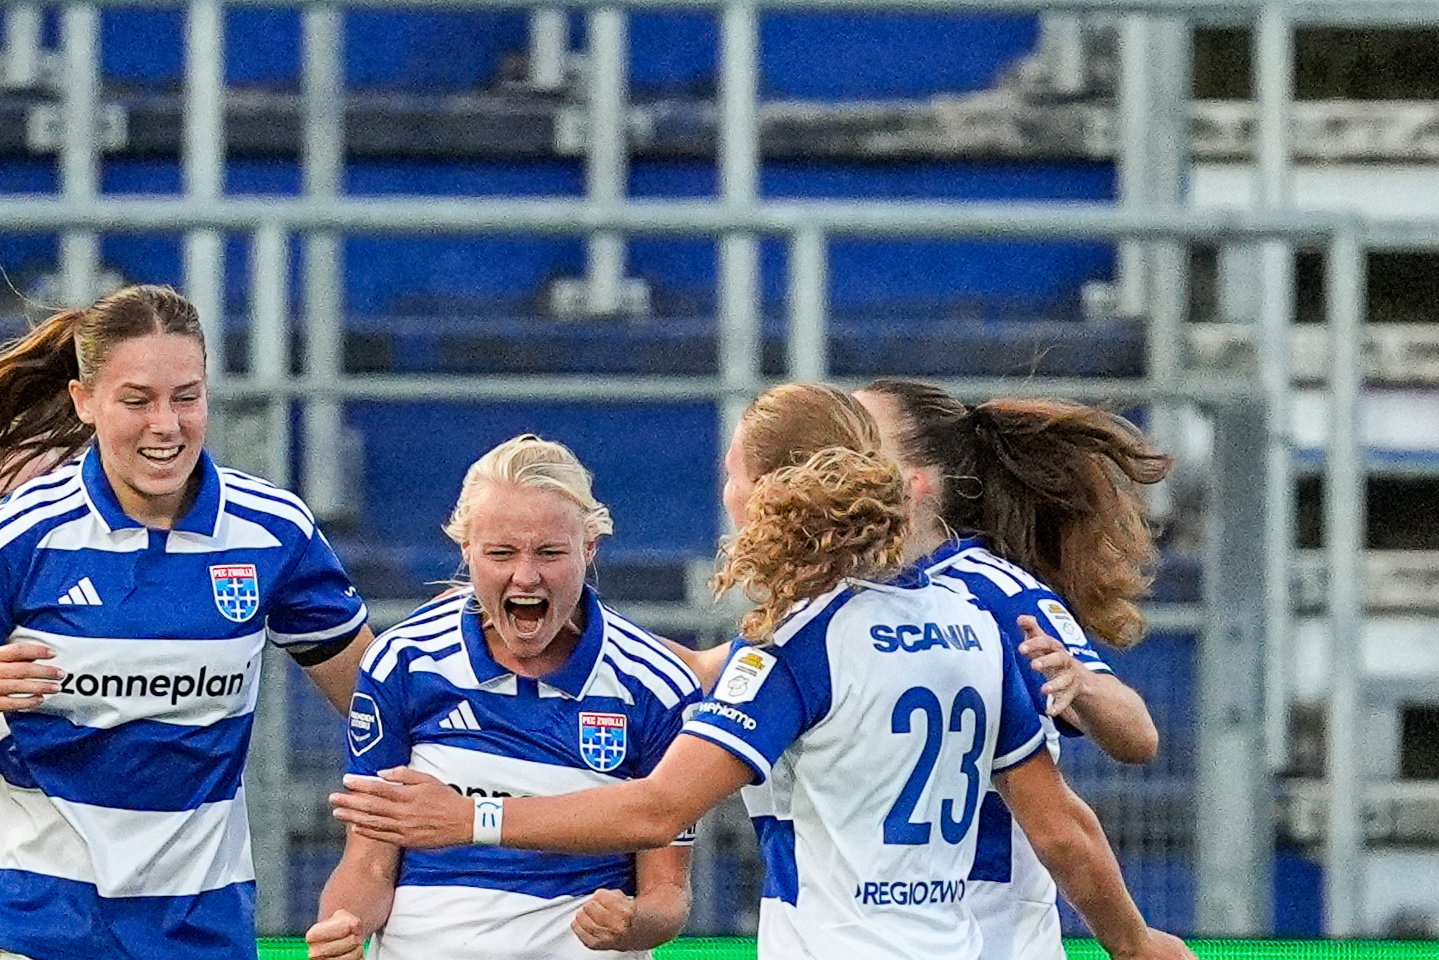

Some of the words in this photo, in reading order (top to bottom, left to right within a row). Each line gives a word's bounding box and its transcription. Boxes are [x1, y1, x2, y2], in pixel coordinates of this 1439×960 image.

[870, 623, 982, 652] SCANIA
[60, 665, 244, 705] zonneplan
[883, 686, 987, 845] 23
